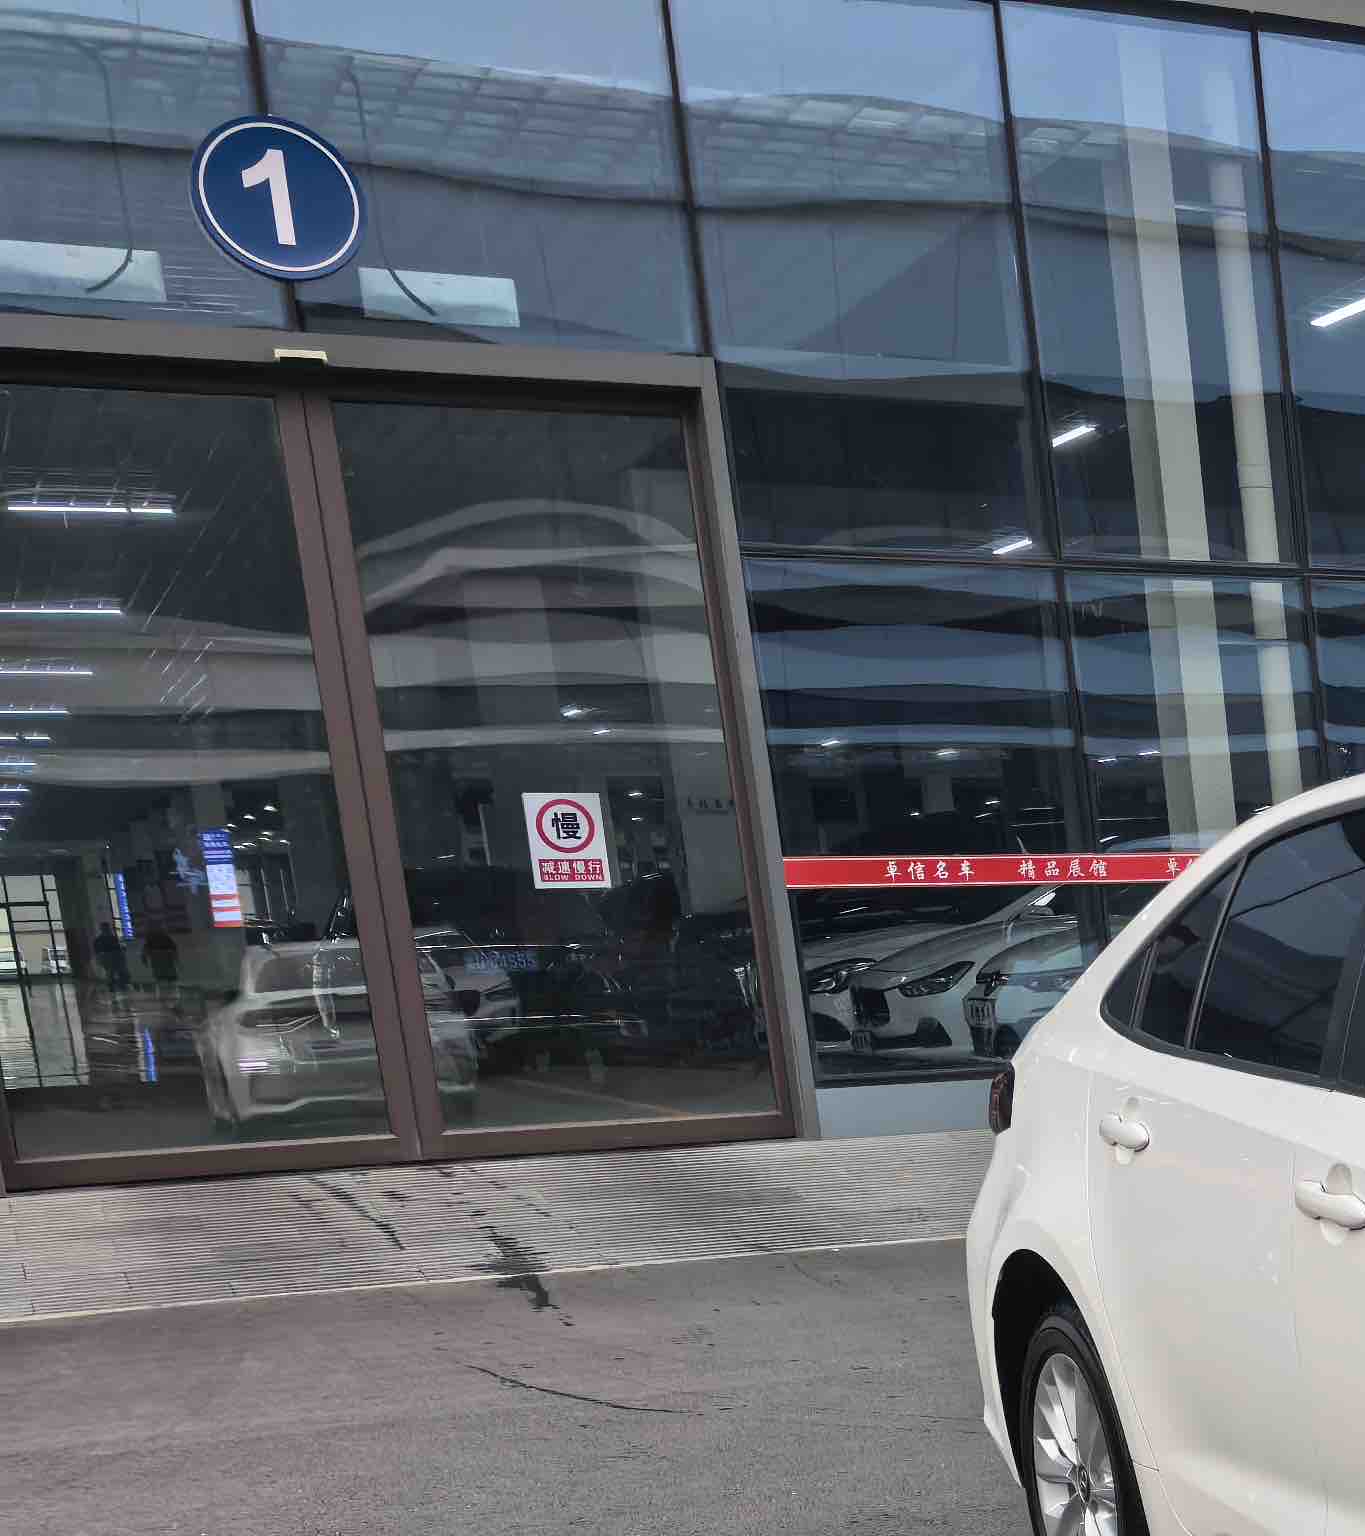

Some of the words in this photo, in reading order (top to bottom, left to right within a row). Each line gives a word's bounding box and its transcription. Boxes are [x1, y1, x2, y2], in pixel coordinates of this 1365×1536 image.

[241, 148, 297, 246] 1
[551, 811, 582, 840] 慢
[541, 860, 601, 874] 减速慢行
[884, 859, 977, 882] 卓信名车
[1017, 856, 1111, 880] 精品展馆
